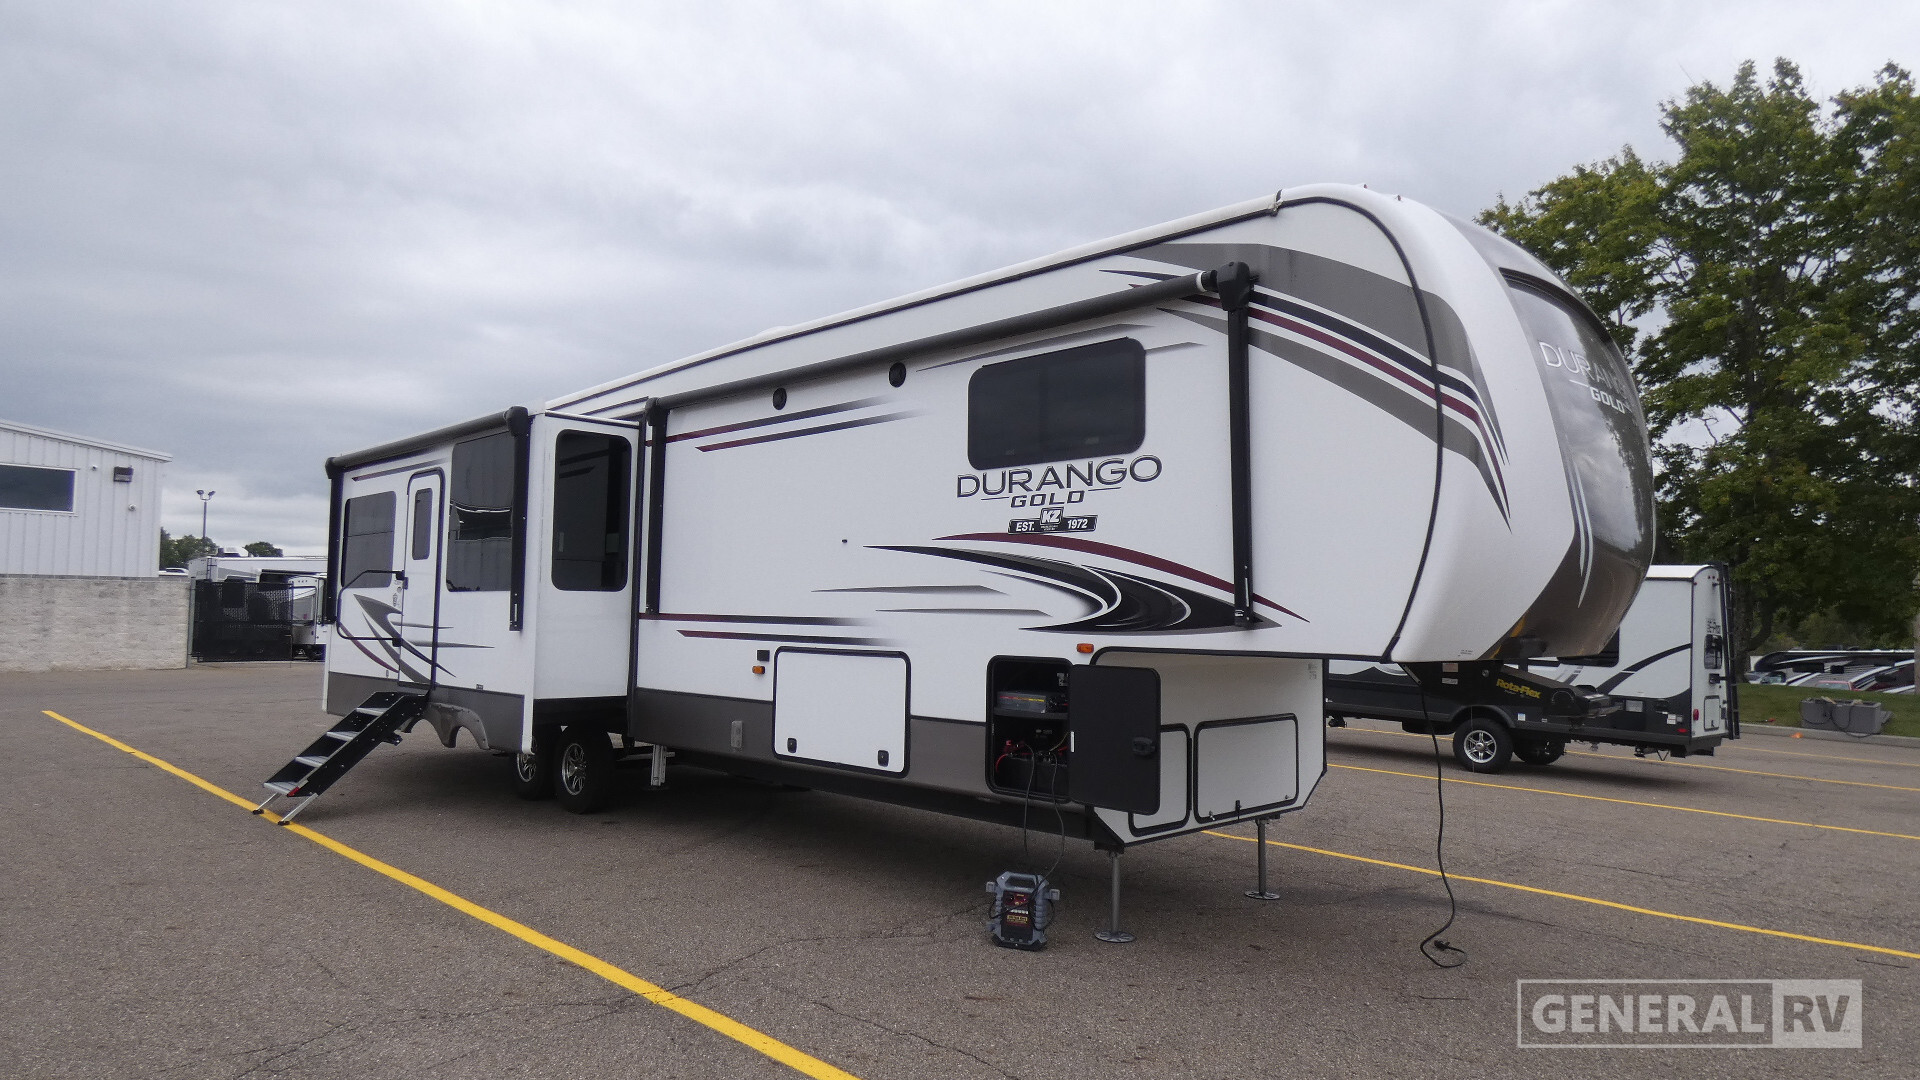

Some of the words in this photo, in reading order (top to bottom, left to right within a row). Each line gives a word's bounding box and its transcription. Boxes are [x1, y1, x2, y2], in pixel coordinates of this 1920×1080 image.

[1589, 386, 1626, 414] GOLD
[956, 454, 1163, 498] DURANGO
[1010, 490, 1085, 508] GOLD
[1015, 521, 1035, 532] EST.
[1067, 518, 1088, 529] 1972
[1041, 509, 1061, 523] KZ
[1496, 678, 1542, 699] Rota-Flex
